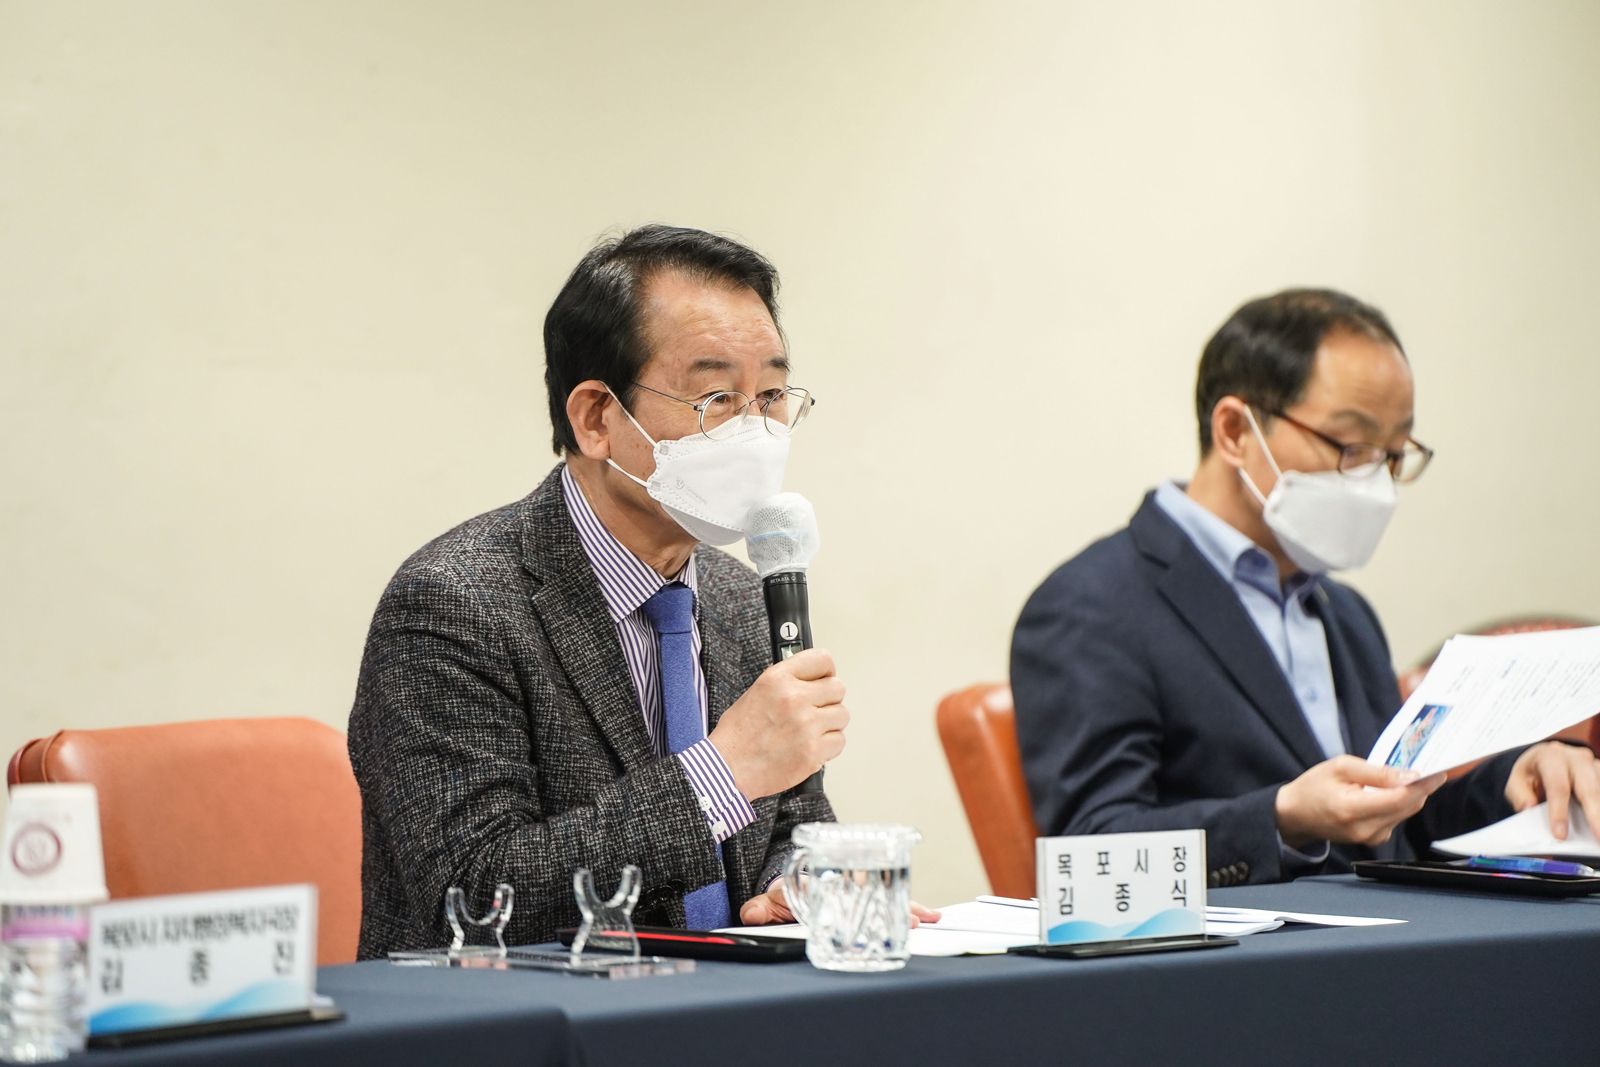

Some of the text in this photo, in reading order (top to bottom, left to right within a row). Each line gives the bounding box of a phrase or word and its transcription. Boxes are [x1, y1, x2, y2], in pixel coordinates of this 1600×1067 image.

[785, 625, 792, 637] 1
[1058, 846, 1188, 880] 목포시장
[1058, 879, 1188, 915] 김종식
